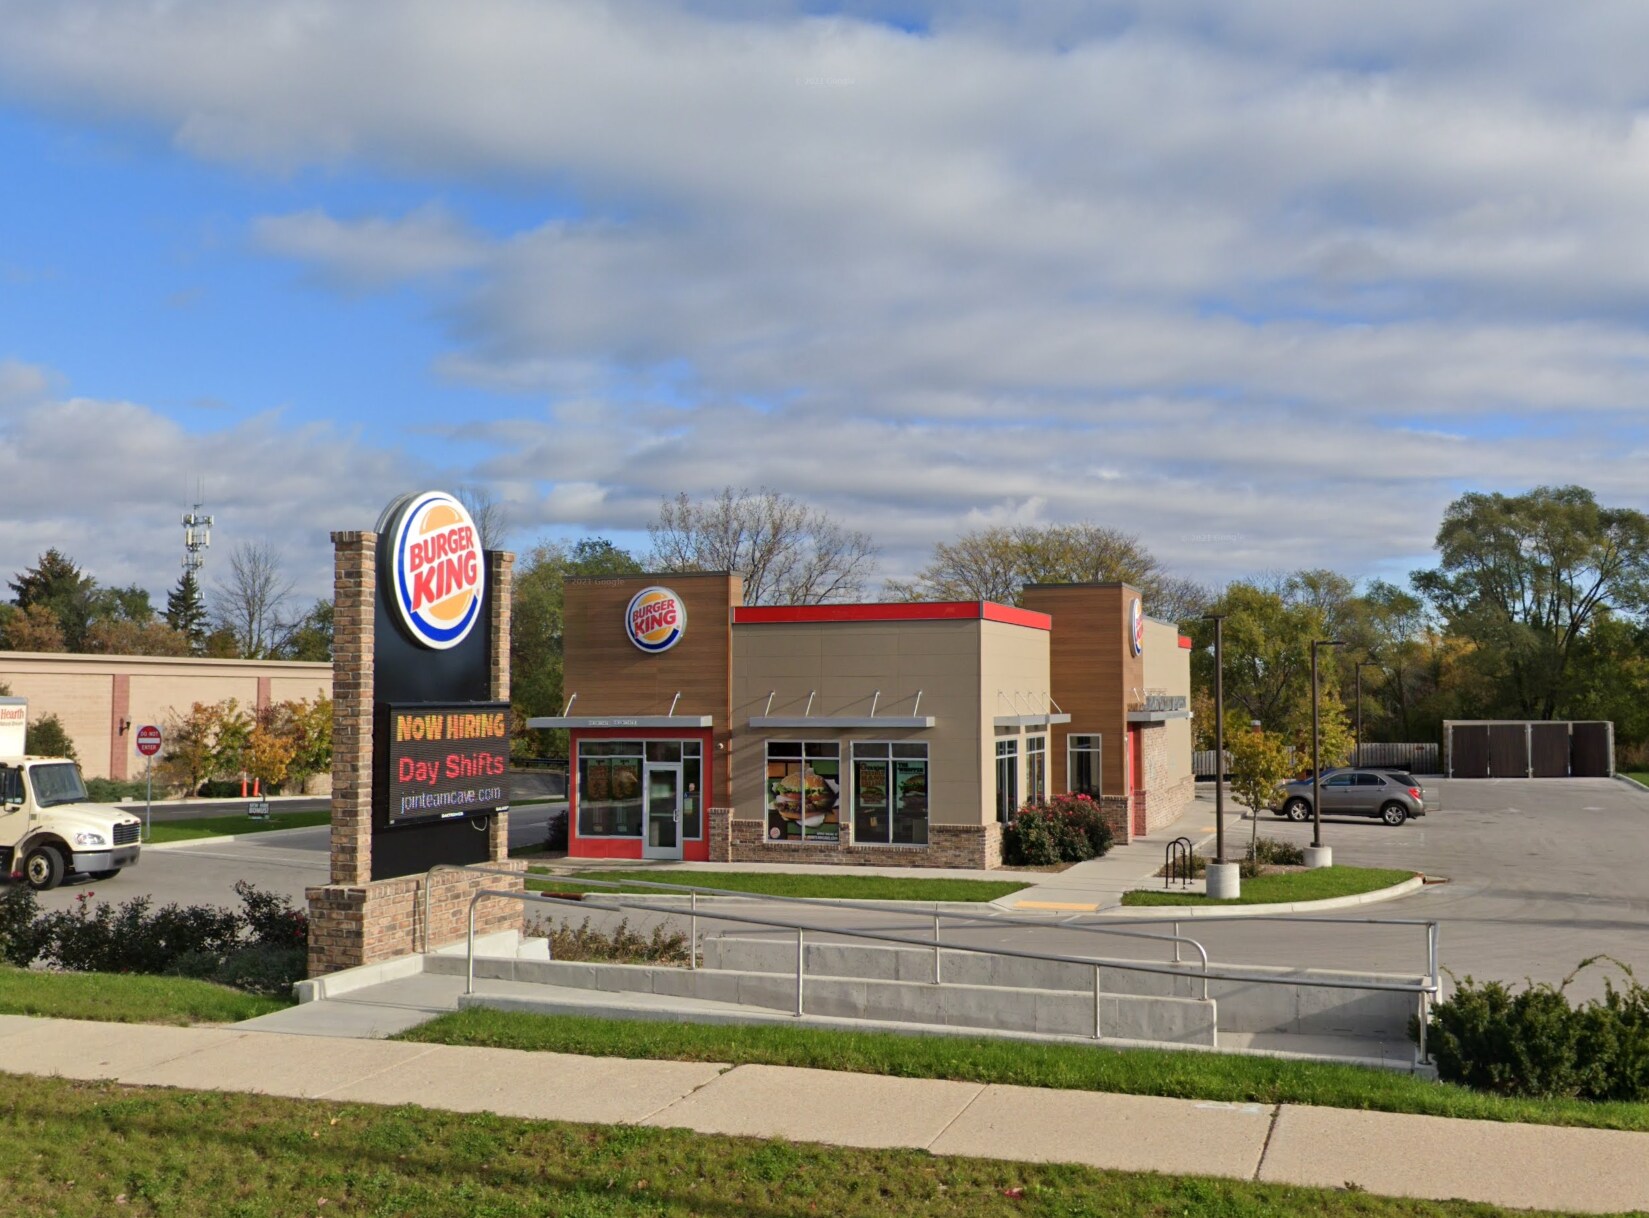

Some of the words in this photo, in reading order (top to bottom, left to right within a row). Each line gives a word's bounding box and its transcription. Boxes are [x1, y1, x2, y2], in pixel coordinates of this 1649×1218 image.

[410, 526, 474, 573] BURGER
[412, 550, 477, 611] KING
[633, 599, 675, 622] BURGER
[634, 609, 677, 639] KING
[0, 708, 25, 720] Hearth
[397, 714, 443, 741] NOW
[446, 713, 505, 740] HIRING
[398, 756, 440, 785] Day
[446, 752, 505, 778] Shifts
